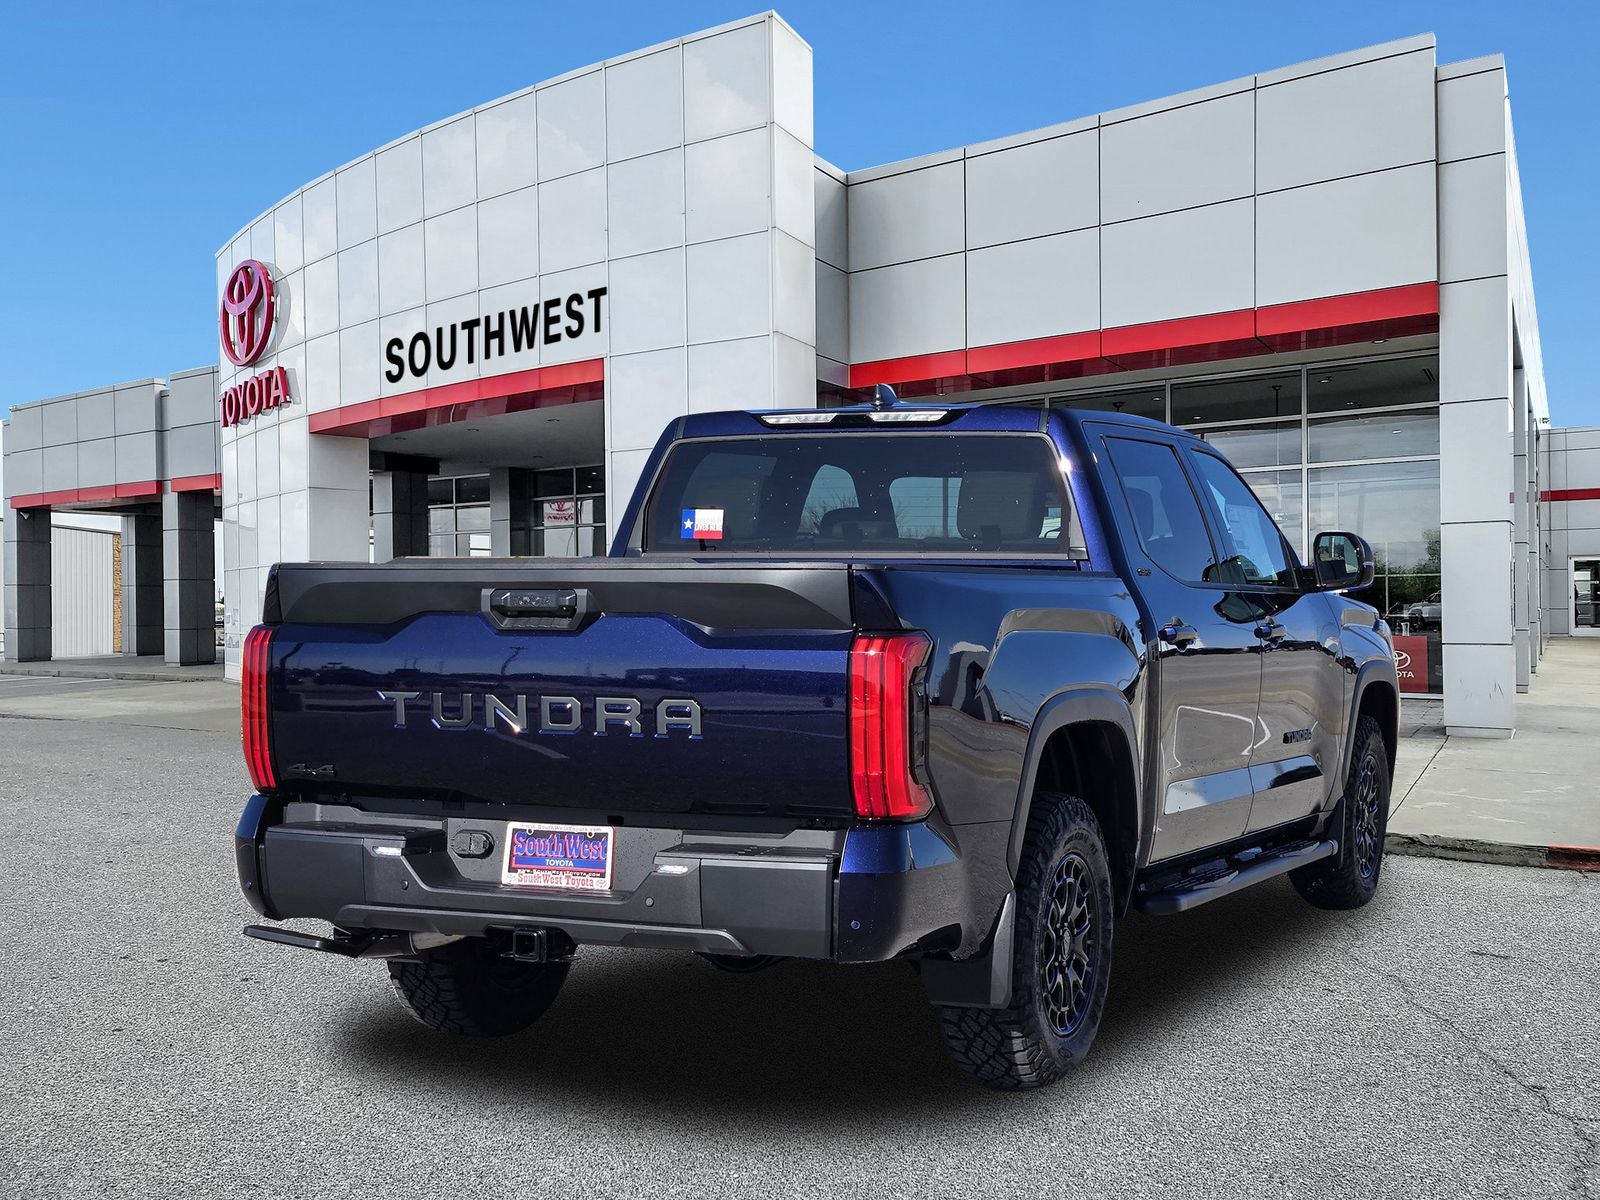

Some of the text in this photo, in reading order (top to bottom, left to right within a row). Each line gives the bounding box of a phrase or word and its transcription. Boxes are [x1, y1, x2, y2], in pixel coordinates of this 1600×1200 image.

[385, 286, 608, 384] SOUTHWEST
[219, 365, 291, 428] TOYOTA
[376, 690, 704, 740] TUNDRA
[513, 831, 608, 860] SouthWest
[545, 859, 574, 867] TOYOTA
[517, 873, 594, 888] SouthWest Toyota
